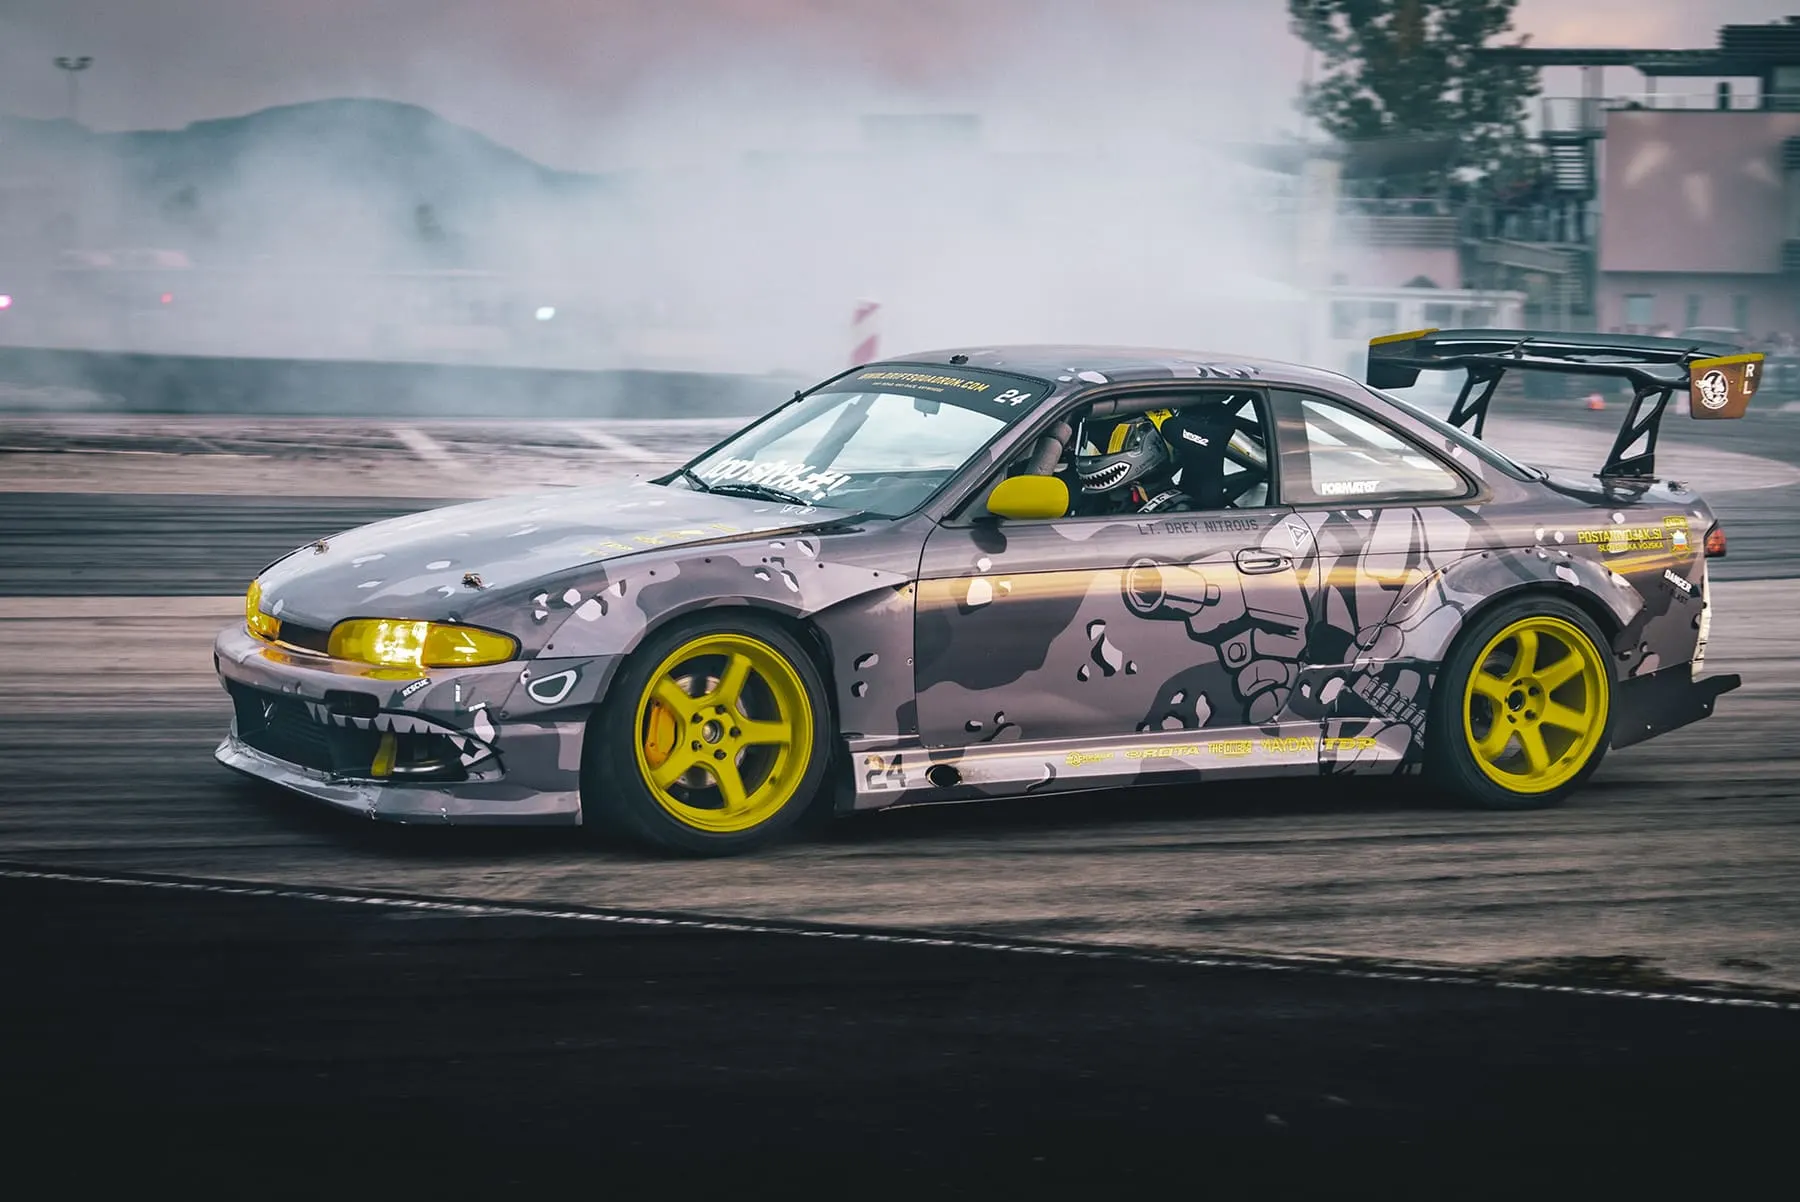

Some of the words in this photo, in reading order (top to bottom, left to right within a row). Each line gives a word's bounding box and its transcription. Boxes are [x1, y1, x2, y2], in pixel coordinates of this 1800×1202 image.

[1745, 363, 1755, 378] R
[1742, 380, 1752, 395] L
[993, 389, 1032, 406] 24
[1137, 523, 1161, 536] LT.
[1165, 521, 1199, 534] DREY
[1204, 519, 1260, 532] NITROUS
[1663, 569, 1692, 593] DANGER
[1142, 745, 1200, 758] ROTA
[1207, 742, 1224, 754] THE
[1262, 736, 1316, 753] MAYDAY
[864, 753, 907, 790] 24
